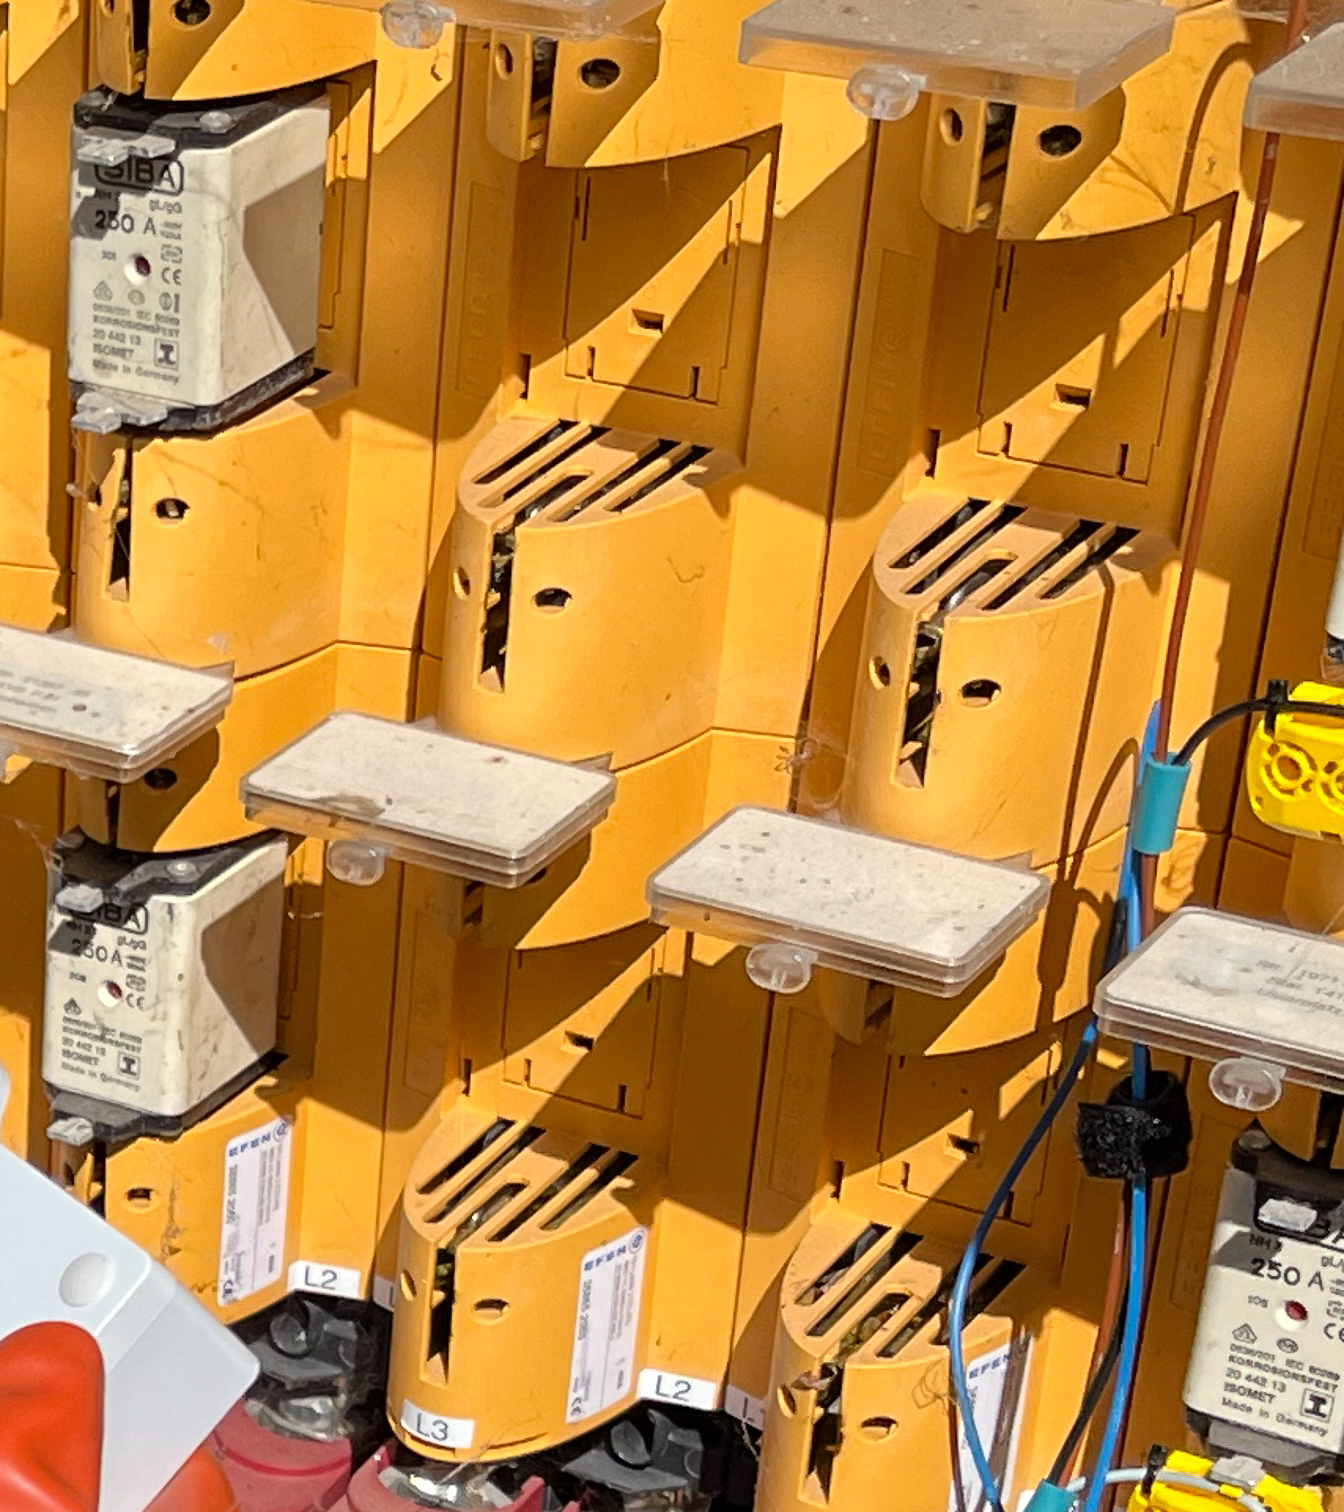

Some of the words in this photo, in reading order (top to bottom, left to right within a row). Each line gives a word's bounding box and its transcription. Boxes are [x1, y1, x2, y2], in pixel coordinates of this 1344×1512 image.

[101, 158, 177, 190] SIBA
[94, 209, 135, 235] 250
[143, 216, 157, 236] A
[135, 364, 180, 386] Germany
[71, 937, 109, 963] 250
[110, 947, 124, 969] A
[228, 1134, 272, 1157] EFEN
[583, 1245, 627, 1272] EFEN
[304, 1265, 338, 1291] L2
[1250, 1257, 1301, 1287] 250
[1307, 1271, 1324, 1291] A
[1228, 1354, 1339, 1393] KORROSIONSFEST
[1271, 1378, 1287, 1394] 13
[654, 1376, 692, 1402] L2
[1223, 1381, 1276, 1406] ISOMET
[416, 1417, 449, 1443] L3
[1221, 1396, 1254, 1416] Made
[1258, 1405, 1270, 1420] in
[1276, 1409, 1329, 1438] Germany
